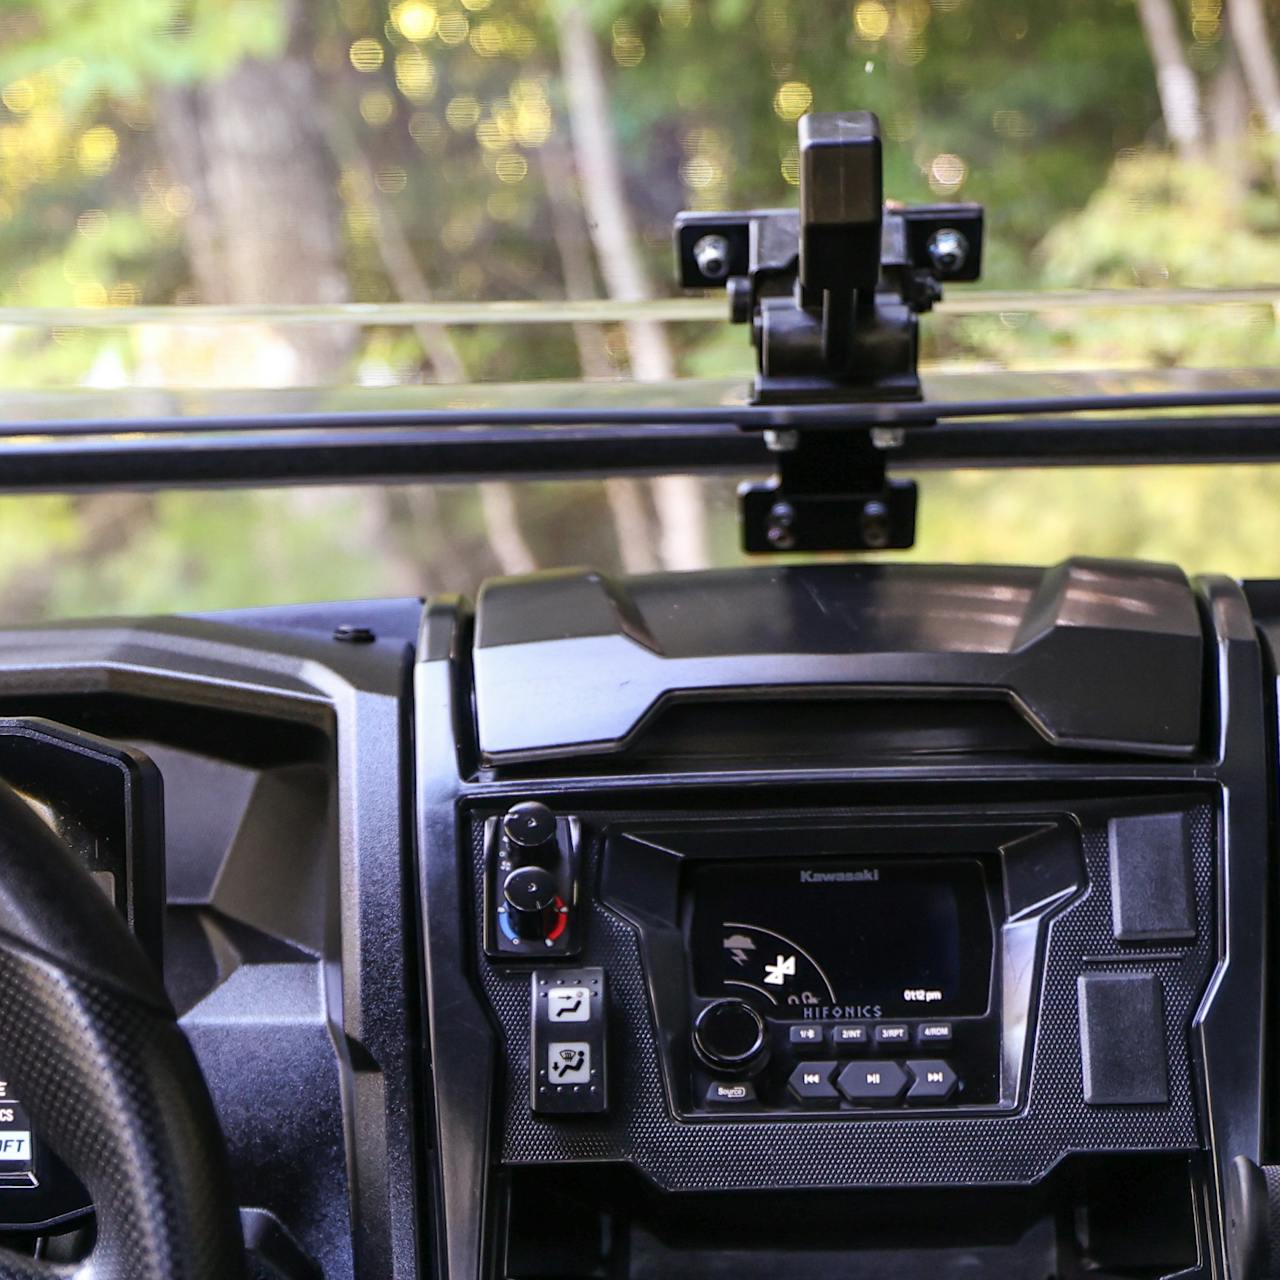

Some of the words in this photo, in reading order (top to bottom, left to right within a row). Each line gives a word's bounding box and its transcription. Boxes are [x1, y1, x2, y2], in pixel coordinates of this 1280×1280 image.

[800, 869, 879, 882] Kawasaki
[926, 990, 942, 1002] pm
[803, 1005, 883, 1020] HIFONICS
